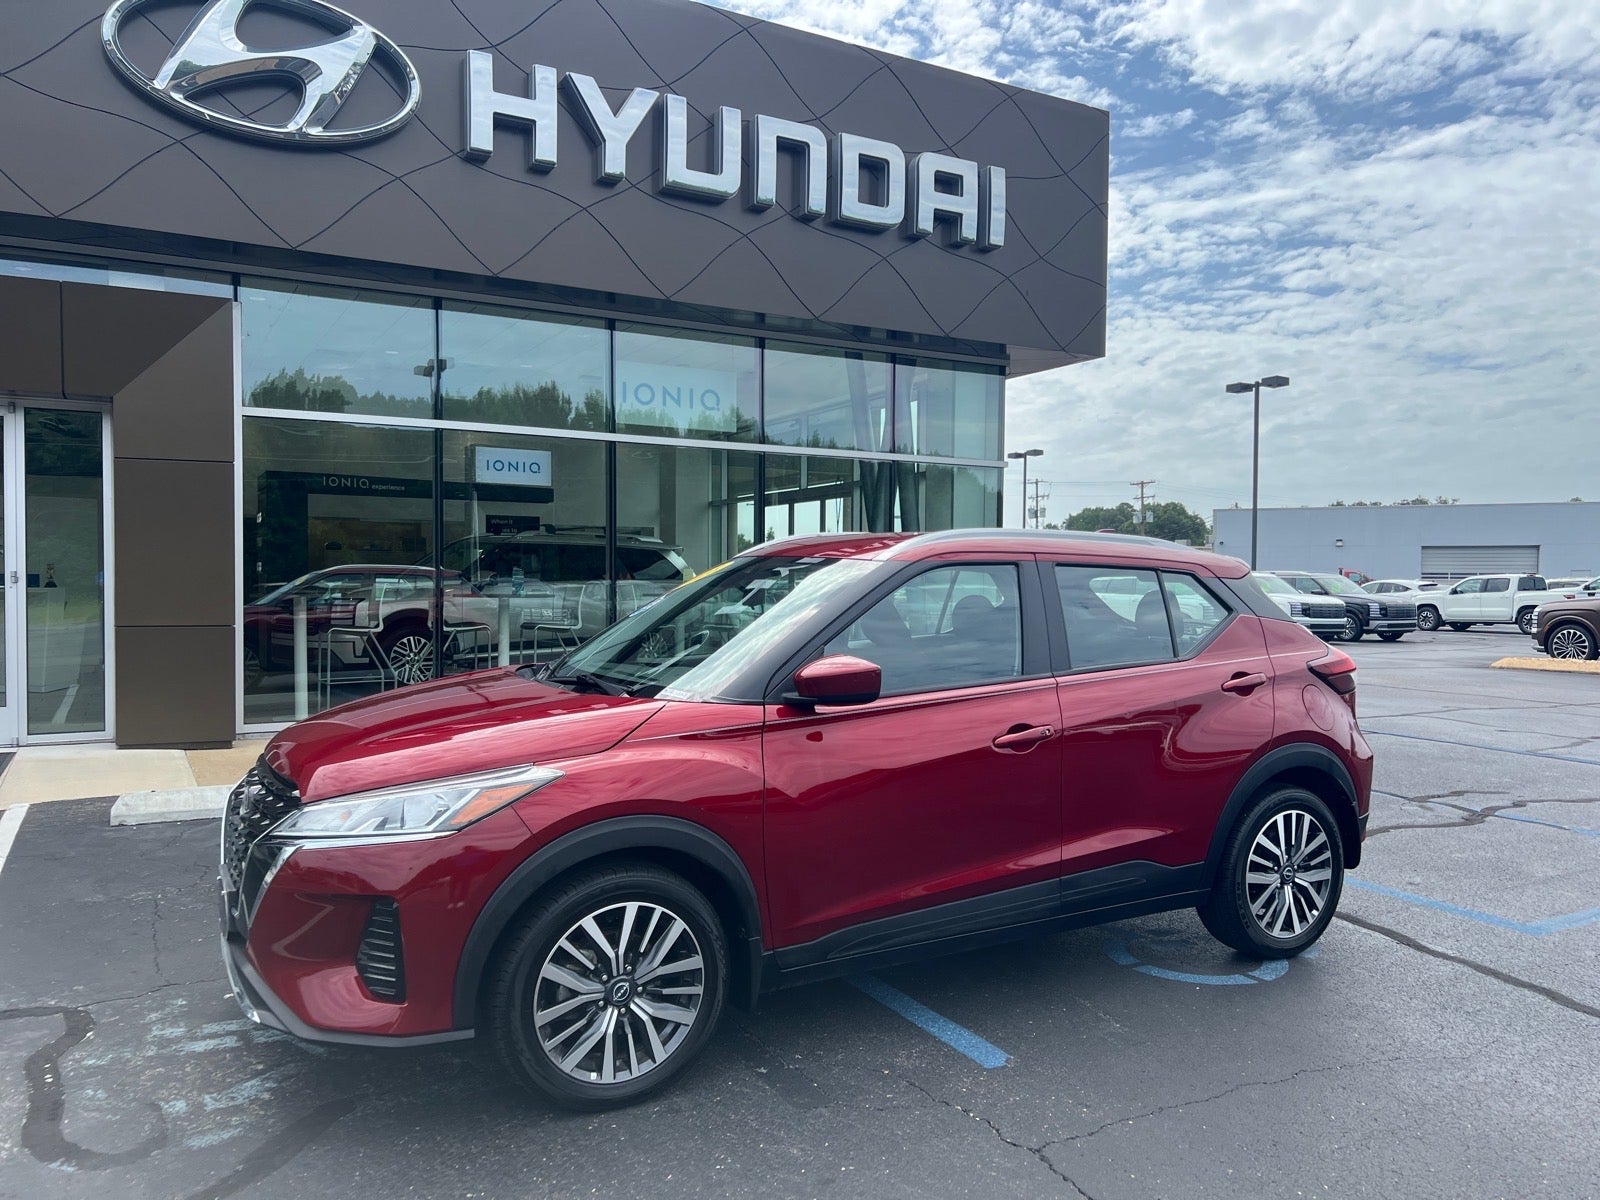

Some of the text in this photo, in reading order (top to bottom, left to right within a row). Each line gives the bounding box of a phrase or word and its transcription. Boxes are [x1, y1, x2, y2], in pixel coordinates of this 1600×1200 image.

[464, 50, 1006, 250] HYUNDAI
[622, 381, 721, 412] IONIQ
[486, 459, 541, 474] IONIQ
[323, 476, 405, 491] IONIQ experience
